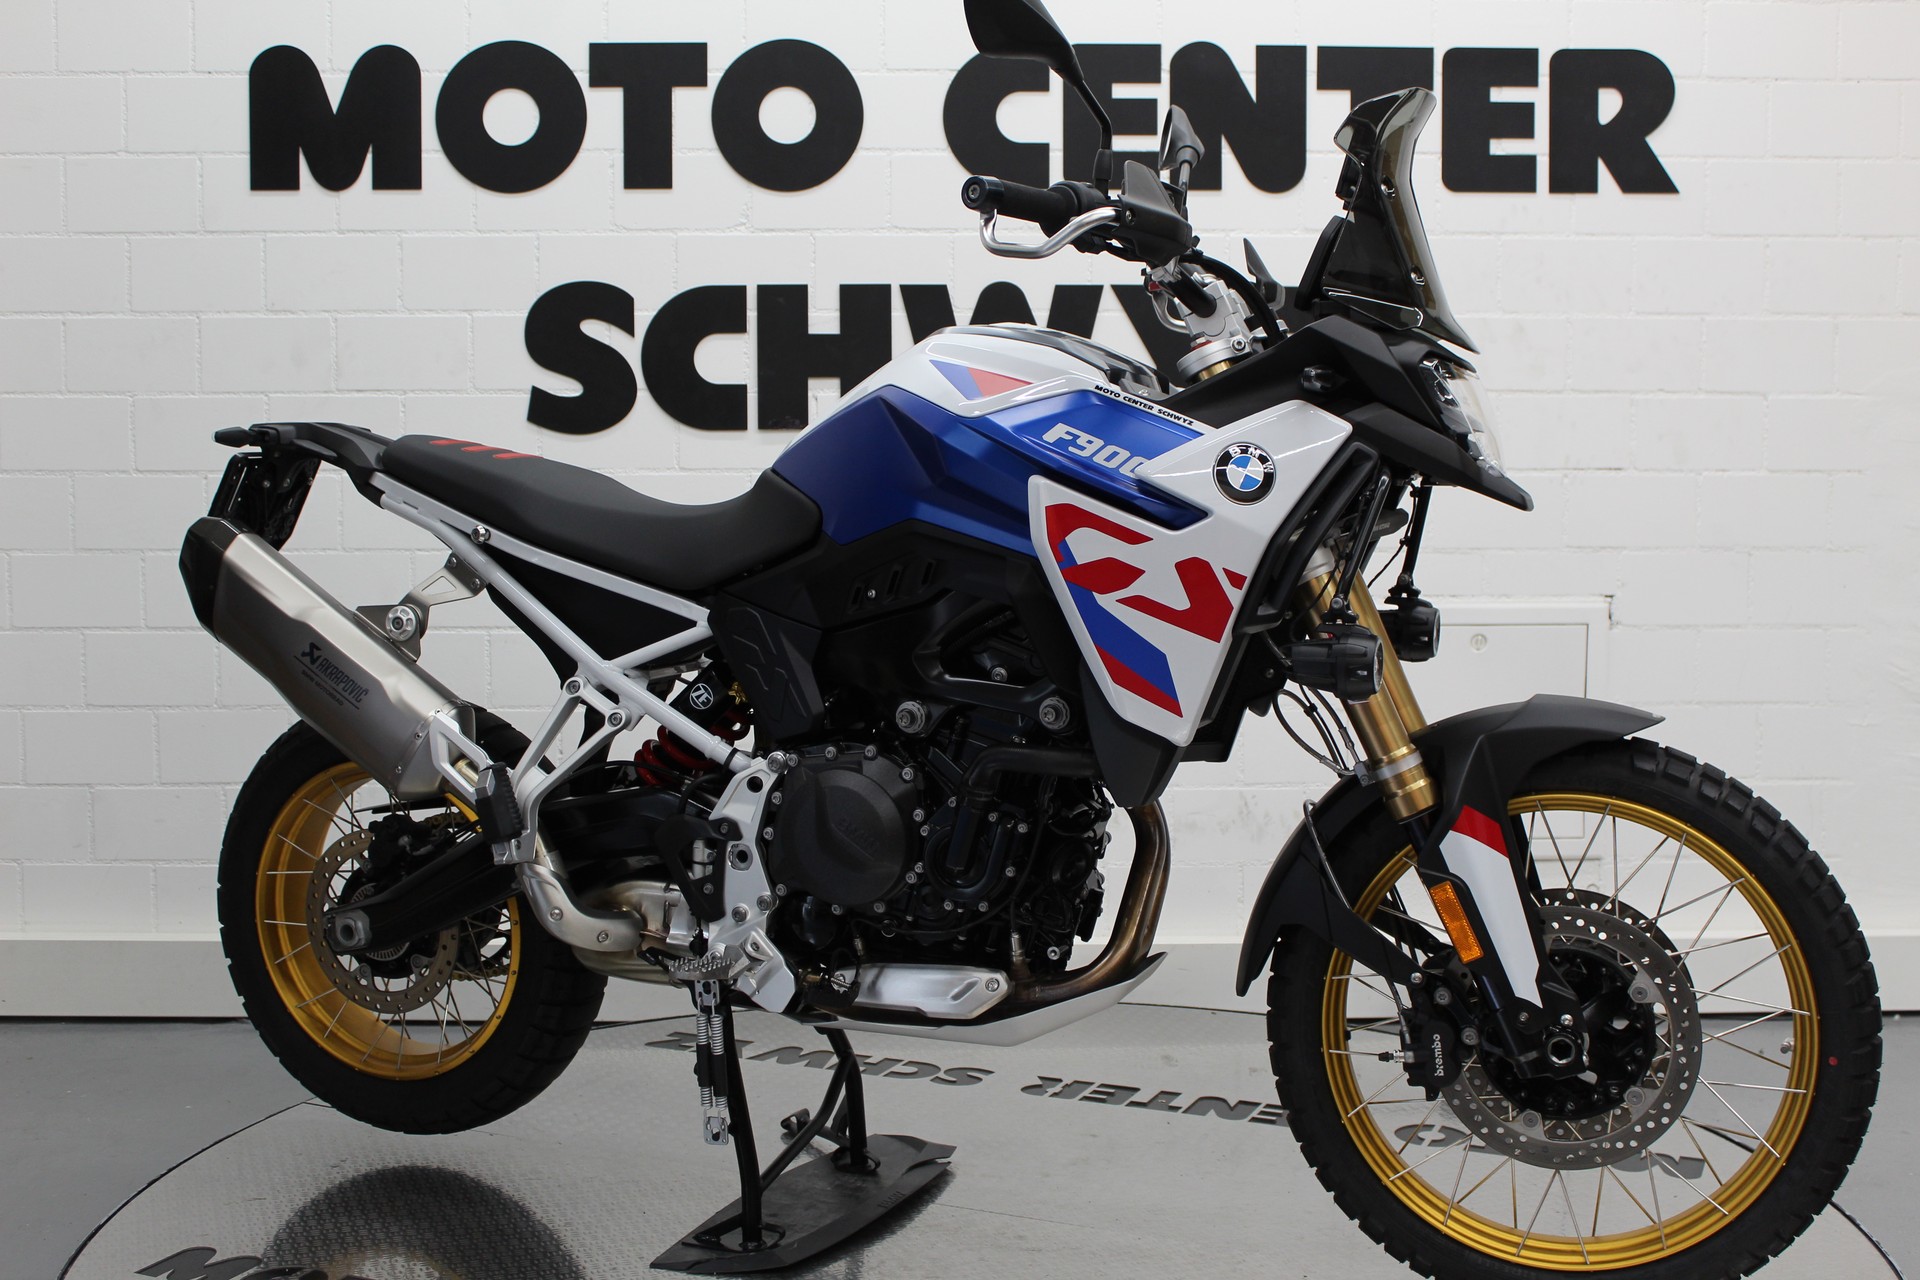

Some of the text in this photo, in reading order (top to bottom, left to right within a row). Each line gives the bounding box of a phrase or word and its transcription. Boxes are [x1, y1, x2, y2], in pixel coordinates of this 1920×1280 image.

[249, 39, 1679, 194] MOTO CENTER
[523, 280, 1300, 435] SCH
[1094, 384, 1195, 426] MOTO CENTER SCHWYZ
[1431, 1033, 1445, 1077] brembo
[1020, 1075, 1292, 1128] ENTER
